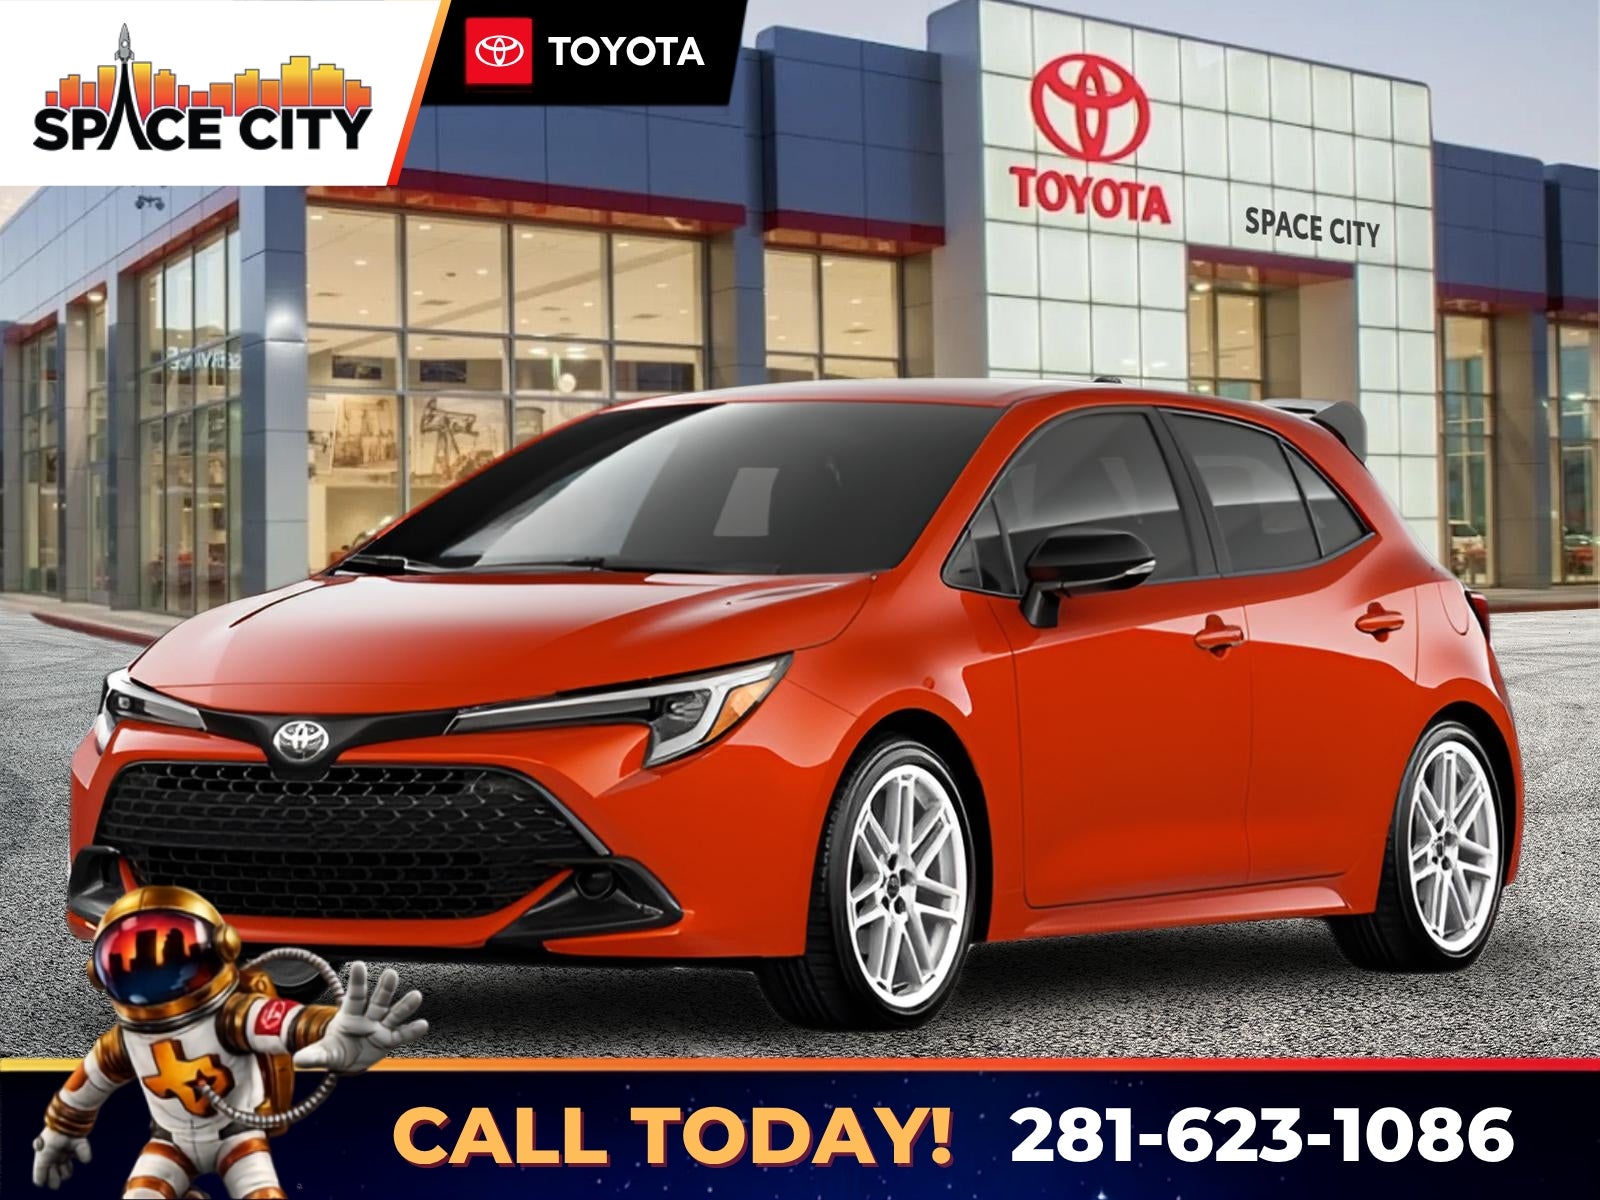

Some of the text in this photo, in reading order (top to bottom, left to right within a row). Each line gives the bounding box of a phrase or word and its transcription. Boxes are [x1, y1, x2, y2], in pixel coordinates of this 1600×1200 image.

[1009, 165, 1172, 224] TOYOTA
[1245, 206, 1381, 248] SPACE CITY
